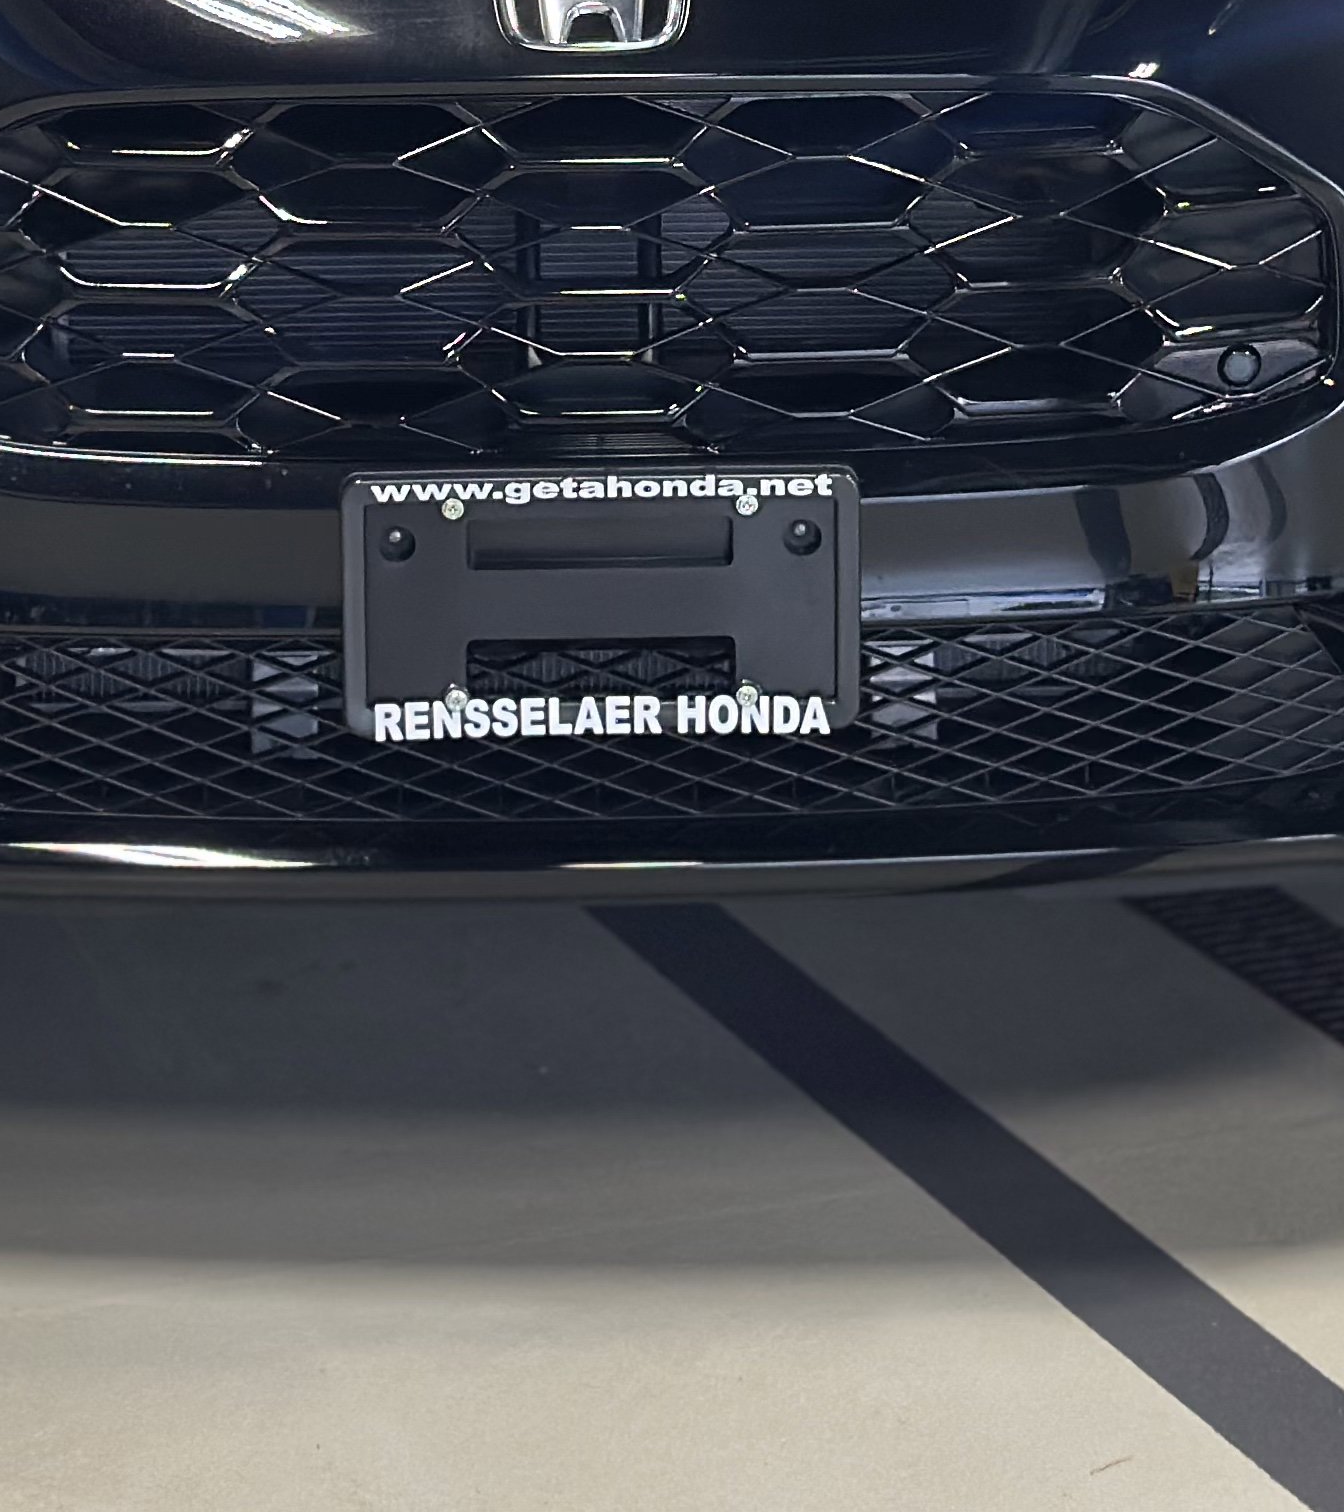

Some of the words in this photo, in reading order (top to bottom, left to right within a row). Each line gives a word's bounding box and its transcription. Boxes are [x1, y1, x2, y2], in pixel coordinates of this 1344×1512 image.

[370, 473, 833, 505] www.getahonda.net
[374, 696, 663, 742] RENSSELAER
[677, 695, 831, 735] HONDA
